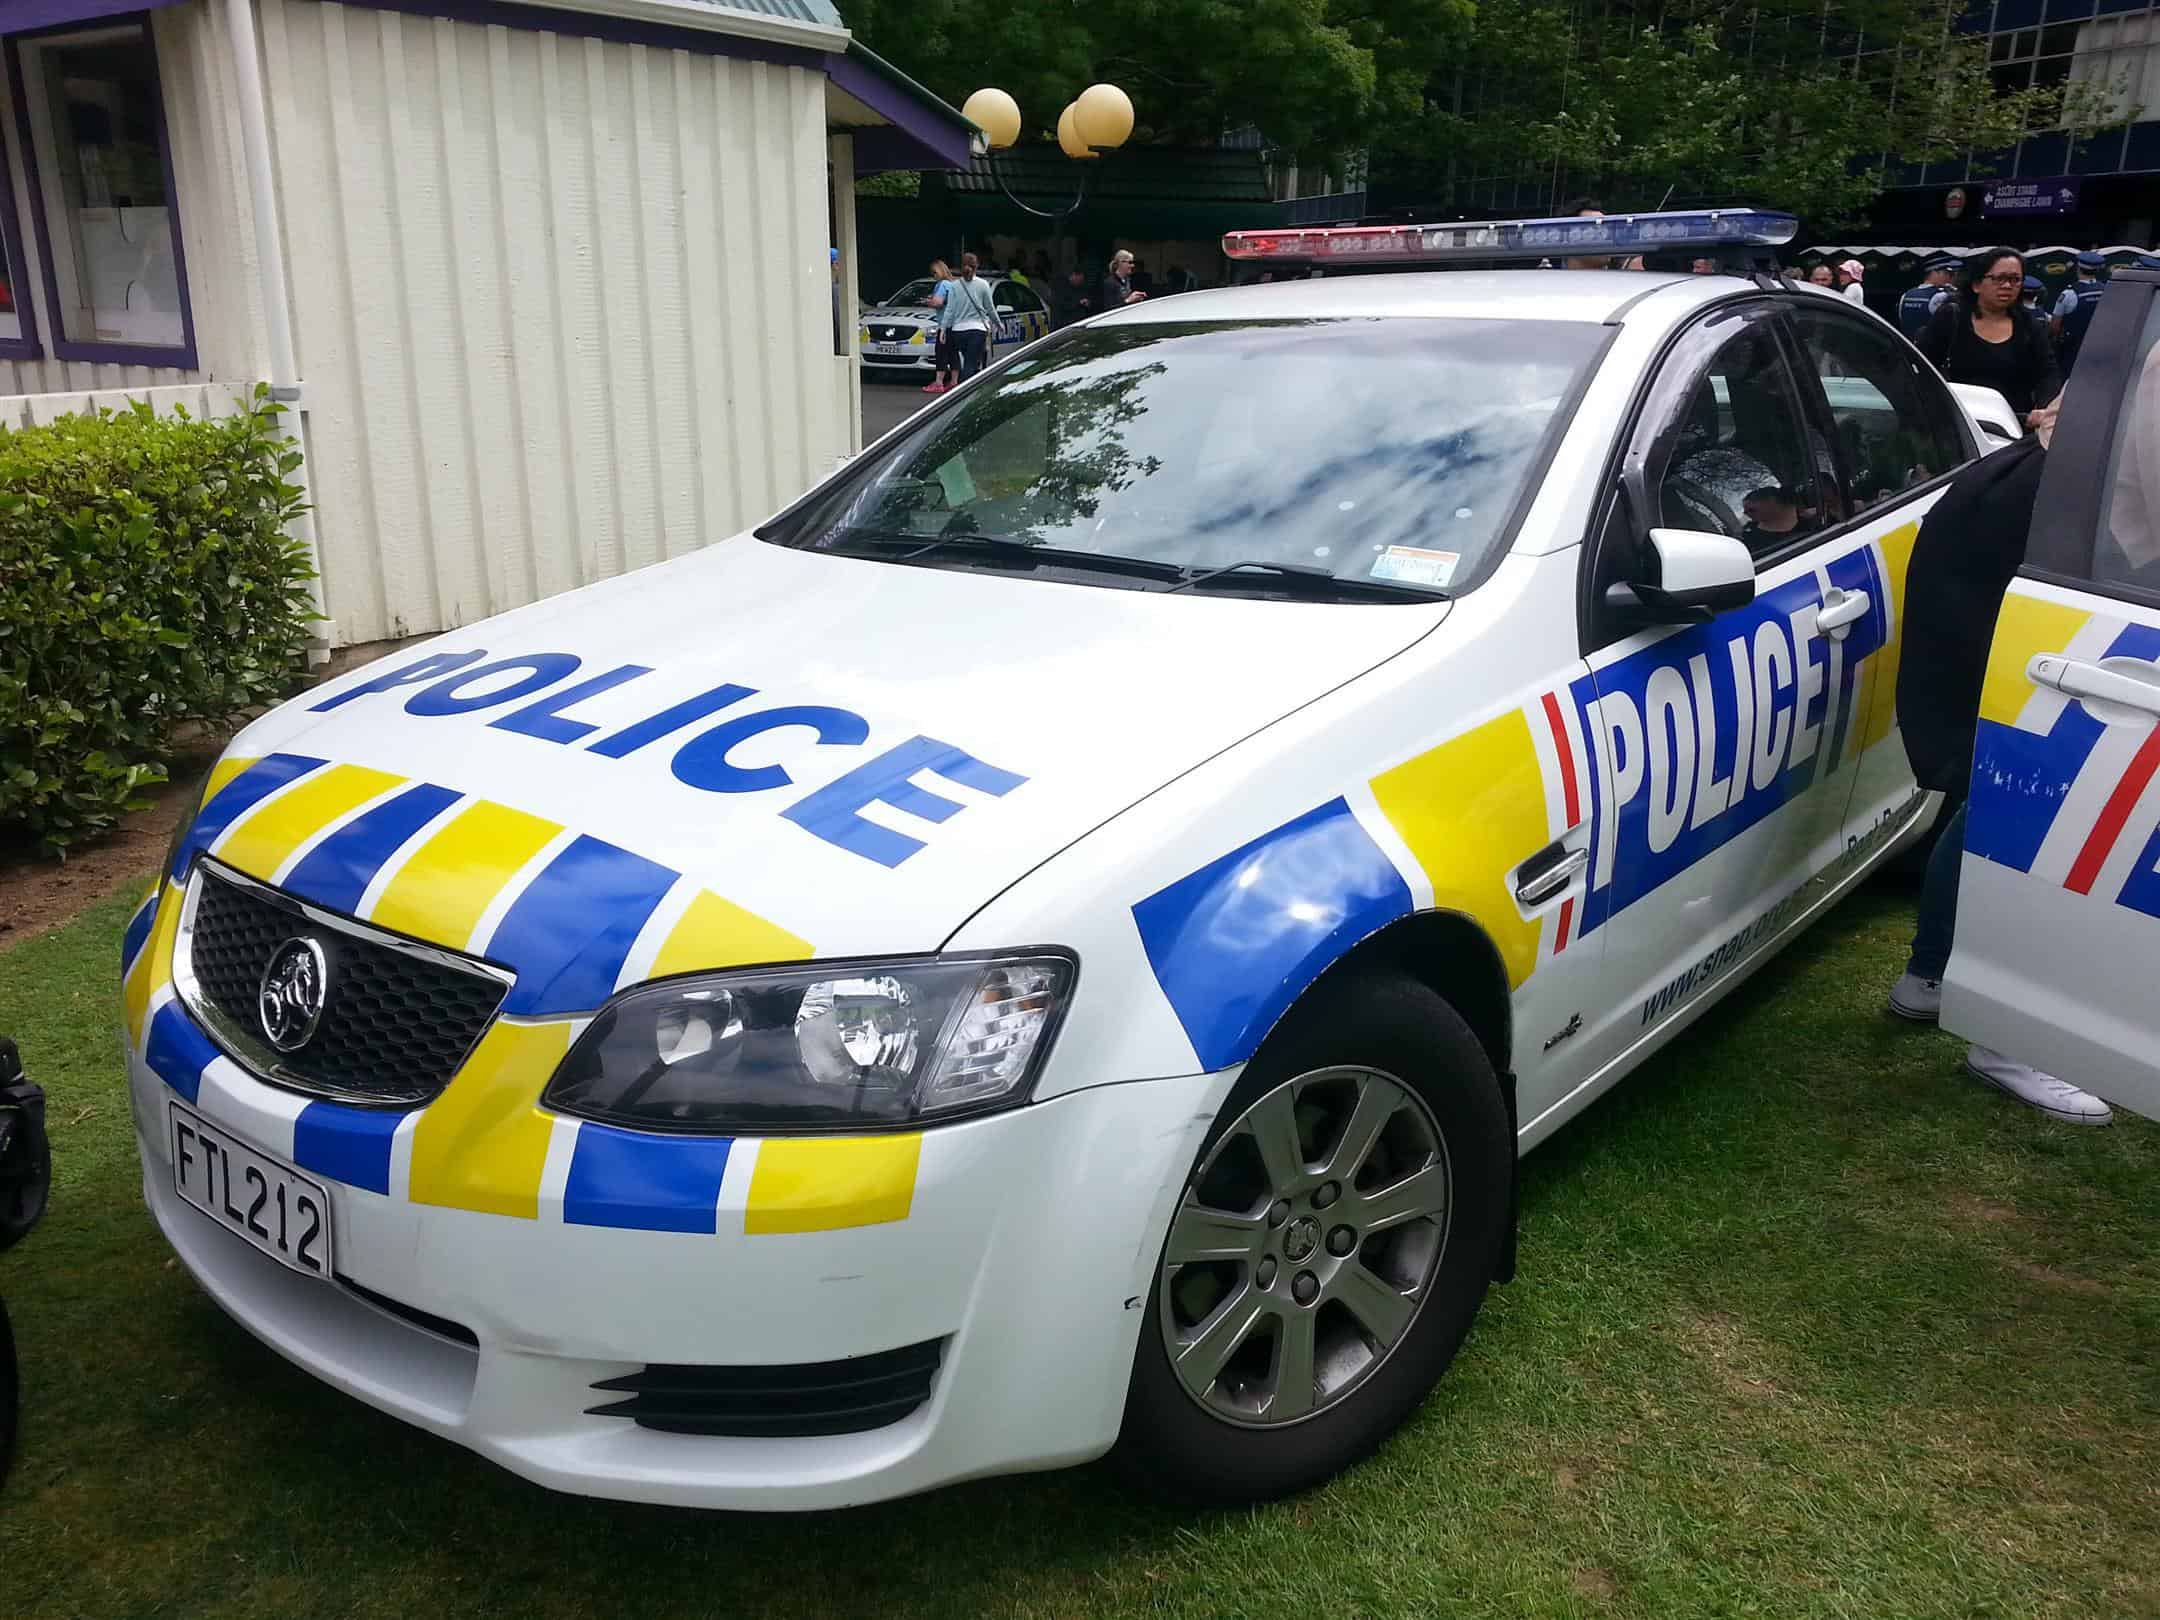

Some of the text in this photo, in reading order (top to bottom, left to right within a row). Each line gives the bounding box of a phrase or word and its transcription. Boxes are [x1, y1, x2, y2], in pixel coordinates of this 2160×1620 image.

[305, 648, 1031, 869] POLICE
[1585, 602, 1824, 893] POLICE
[176, 1119, 322, 1273] FTL212
